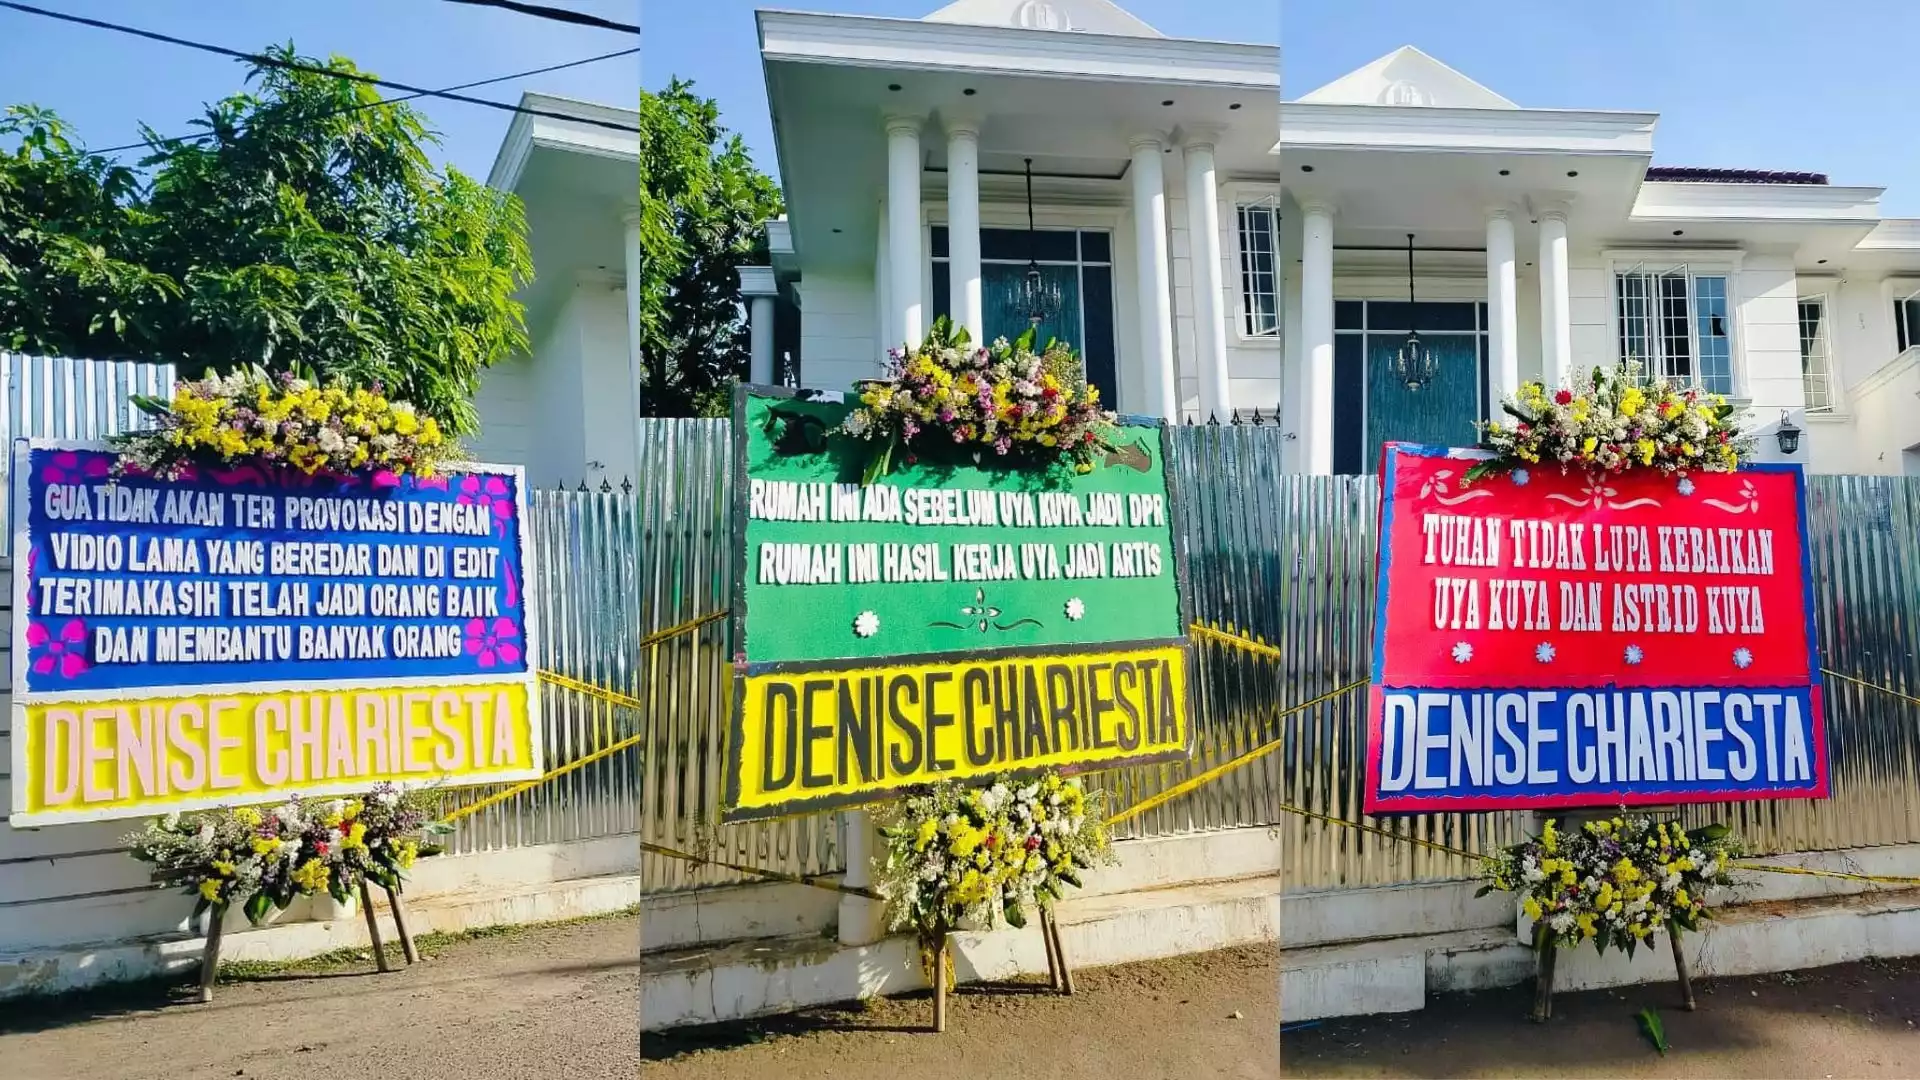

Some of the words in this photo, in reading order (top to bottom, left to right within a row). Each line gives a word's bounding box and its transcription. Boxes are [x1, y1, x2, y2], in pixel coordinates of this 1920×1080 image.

[45, 484, 92, 520] GUA
[93, 484, 159, 523] TIDAK
[163, 489, 224, 527] AKAN
[232, 494, 275, 528] TER
[285, 496, 402, 532] PROVOKASI
[408, 503, 490, 535] DENGAN
[750, 479, 826, 522] RUMAH
[830, 483, 860, 521] INI
[862, 484, 900, 523] ADA
[904, 488, 998, 525] SEBELUM
[1000, 491, 1035, 527] UYA
[1039, 492, 1080, 526] KUYA
[1085, 493, 1123, 526] JADI
[1128, 494, 1165, 527] DPR
[51, 532, 123, 571] VIDIO
[129, 535, 200, 573] LAMA
[206, 539, 265, 574] YANG
[271, 542, 370, 576] BEREDAR
[378, 545, 418, 577] DAN
[425, 546, 444, 578] DI
[453, 547, 499, 579] EDIT
[760, 542, 841, 584] RUMAH
[848, 543, 878, 583] INI
[883, 543, 948, 582] HASIL
[953, 544, 1017, 581] KERJA
[1021, 544, 1059, 580] UYA
[1064, 542, 1106, 579] JADI
[1111, 541, 1162, 577] ARTIS
[1423, 513, 1501, 566] TUHAN
[1510, 519, 1587, 570] TIDAK
[1592, 524, 1652, 572] LUPA
[1658, 525, 1774, 575] KEBAIKAN
[39, 577, 220, 617] TERIMAKASIH
[228, 582, 309, 617] TELAH
[316, 583, 365, 616] JADI
[371, 584, 438, 617] ORANG
[446, 585, 499, 617] BAIK
[1434, 577, 1480, 629] UYA
[1488, 577, 1550, 630] KUYA
[1559, 581, 1602, 632] DAN
[1612, 584, 1698, 632] ASTRID
[1706, 586, 1764, 634] KUYA
[95, 627, 147, 663] DAN
[156, 625, 290, 662] MEMBANTU
[299, 625, 386, 659] BANYAK
[393, 625, 461, 657] ORANG
[45, 699, 242, 805] DENISE
[255, 691, 517, 786] CHARIESTA
[763, 672, 955, 791] DENISE
[965, 659, 1178, 767] CHARIESTA
[1380, 692, 1558, 791] DENISE
[1566, 691, 1810, 783] CHARIESTA
